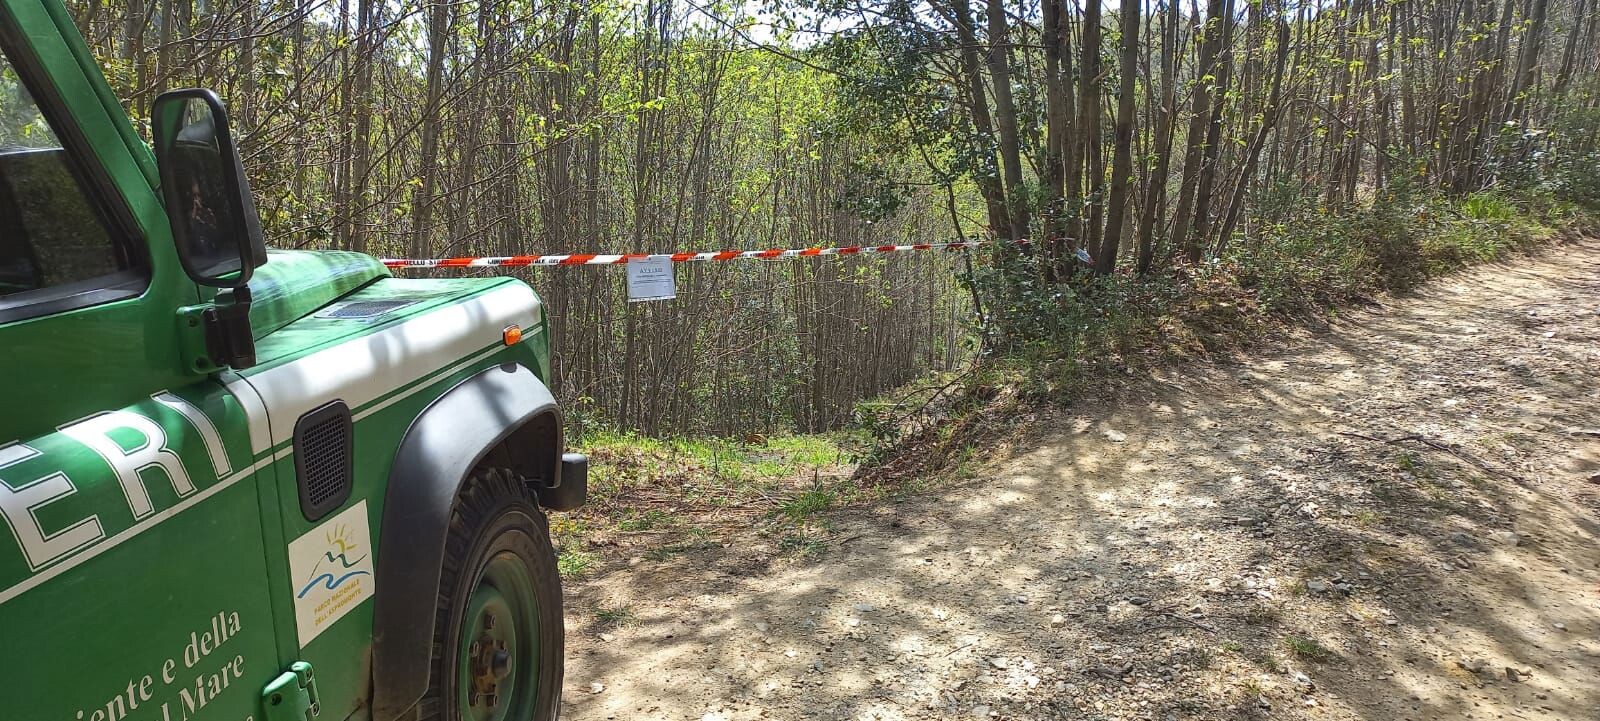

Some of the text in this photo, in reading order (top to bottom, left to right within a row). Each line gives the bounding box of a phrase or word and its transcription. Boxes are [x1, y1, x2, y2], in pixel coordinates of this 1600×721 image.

[314, 578, 360, 616] PARCO NAZIONALE
[162, 658, 177, 685] e
[184, 610, 242, 669] della
[179, 654, 245, 721] Mare
